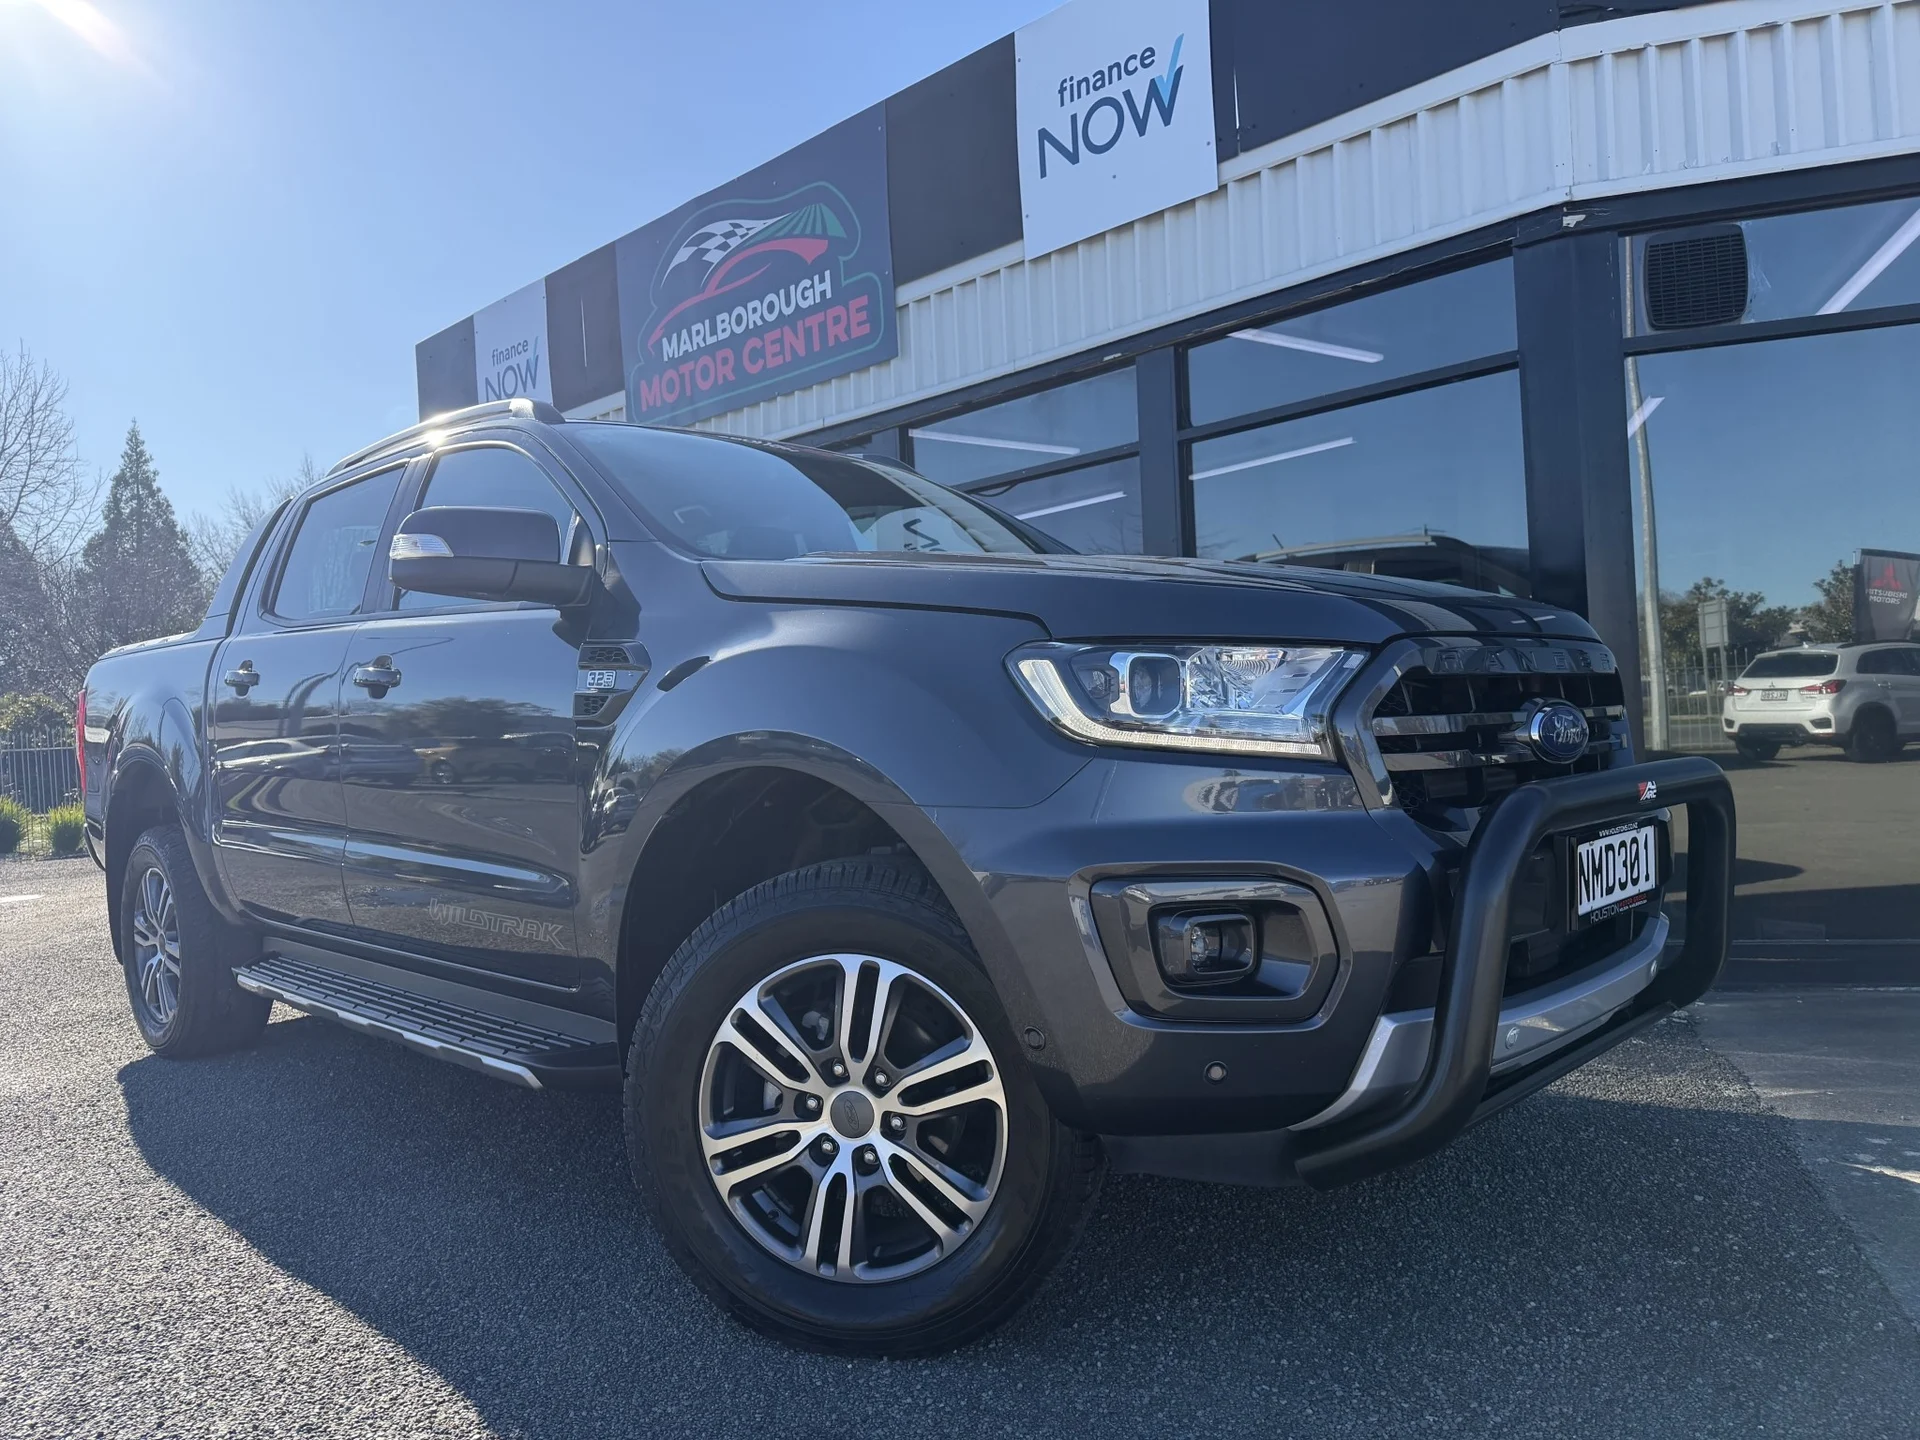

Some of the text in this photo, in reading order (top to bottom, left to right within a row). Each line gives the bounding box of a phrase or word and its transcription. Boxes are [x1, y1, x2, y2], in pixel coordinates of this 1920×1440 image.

[1058, 46, 1156, 108] finance
[1037, 64, 1184, 179] NOW
[661, 269, 832, 362] MARLBOROUGH
[484, 354, 539, 403] NOW
[492, 339, 529, 367] finance
[640, 295, 870, 412] MOTOR CENTRE
[1869, 595, 1901, 605] MOTORS
[1551, 714, 1588, 745] Ford
[1578, 832, 1650, 906] NMD301
[428, 898, 567, 950] WILDTRAK
[1590, 903, 1620, 925] HOUSTON
